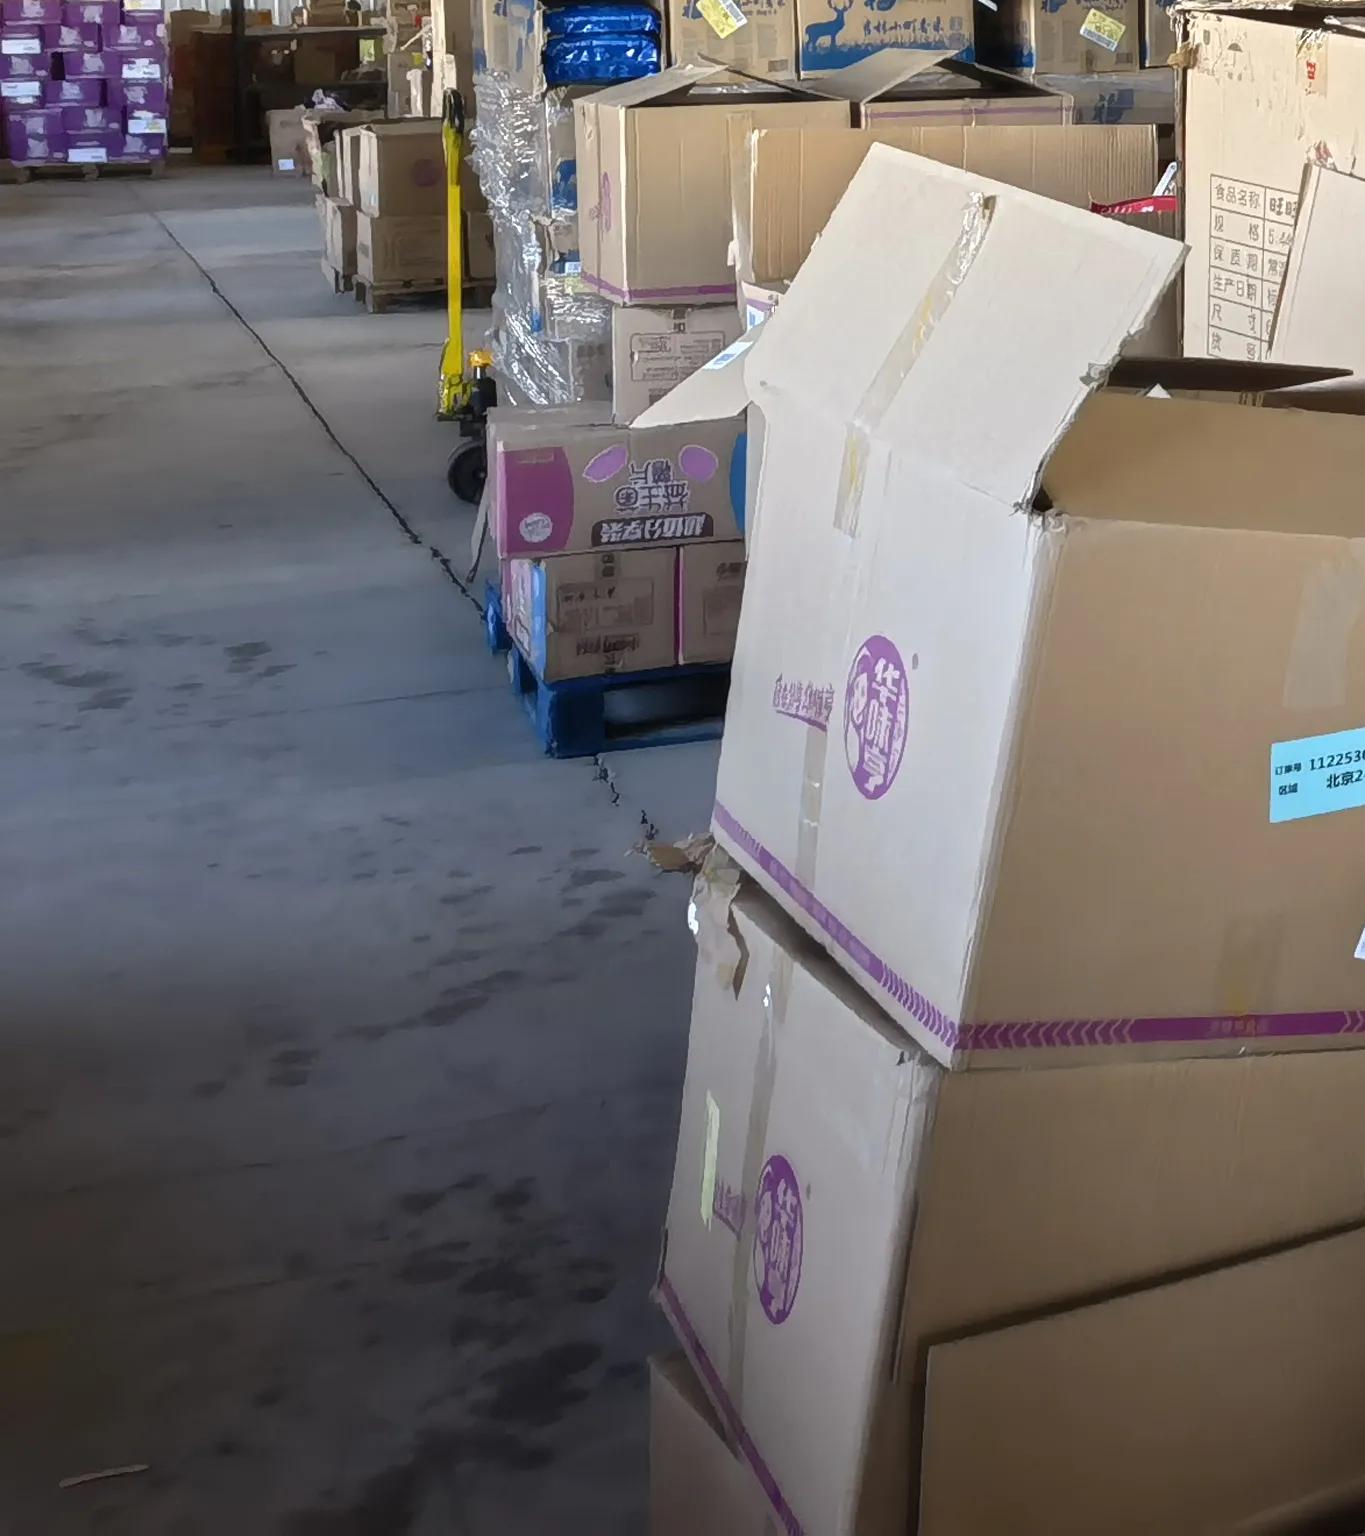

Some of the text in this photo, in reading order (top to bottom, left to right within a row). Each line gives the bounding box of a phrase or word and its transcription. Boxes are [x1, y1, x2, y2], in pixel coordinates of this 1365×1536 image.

[1215, 184, 1260, 209] 食品名称
[1214, 275, 1257, 301] 生产日期
[615, 483, 688, 513] 益生菌
[601, 514, 706, 543] 超值分享装
